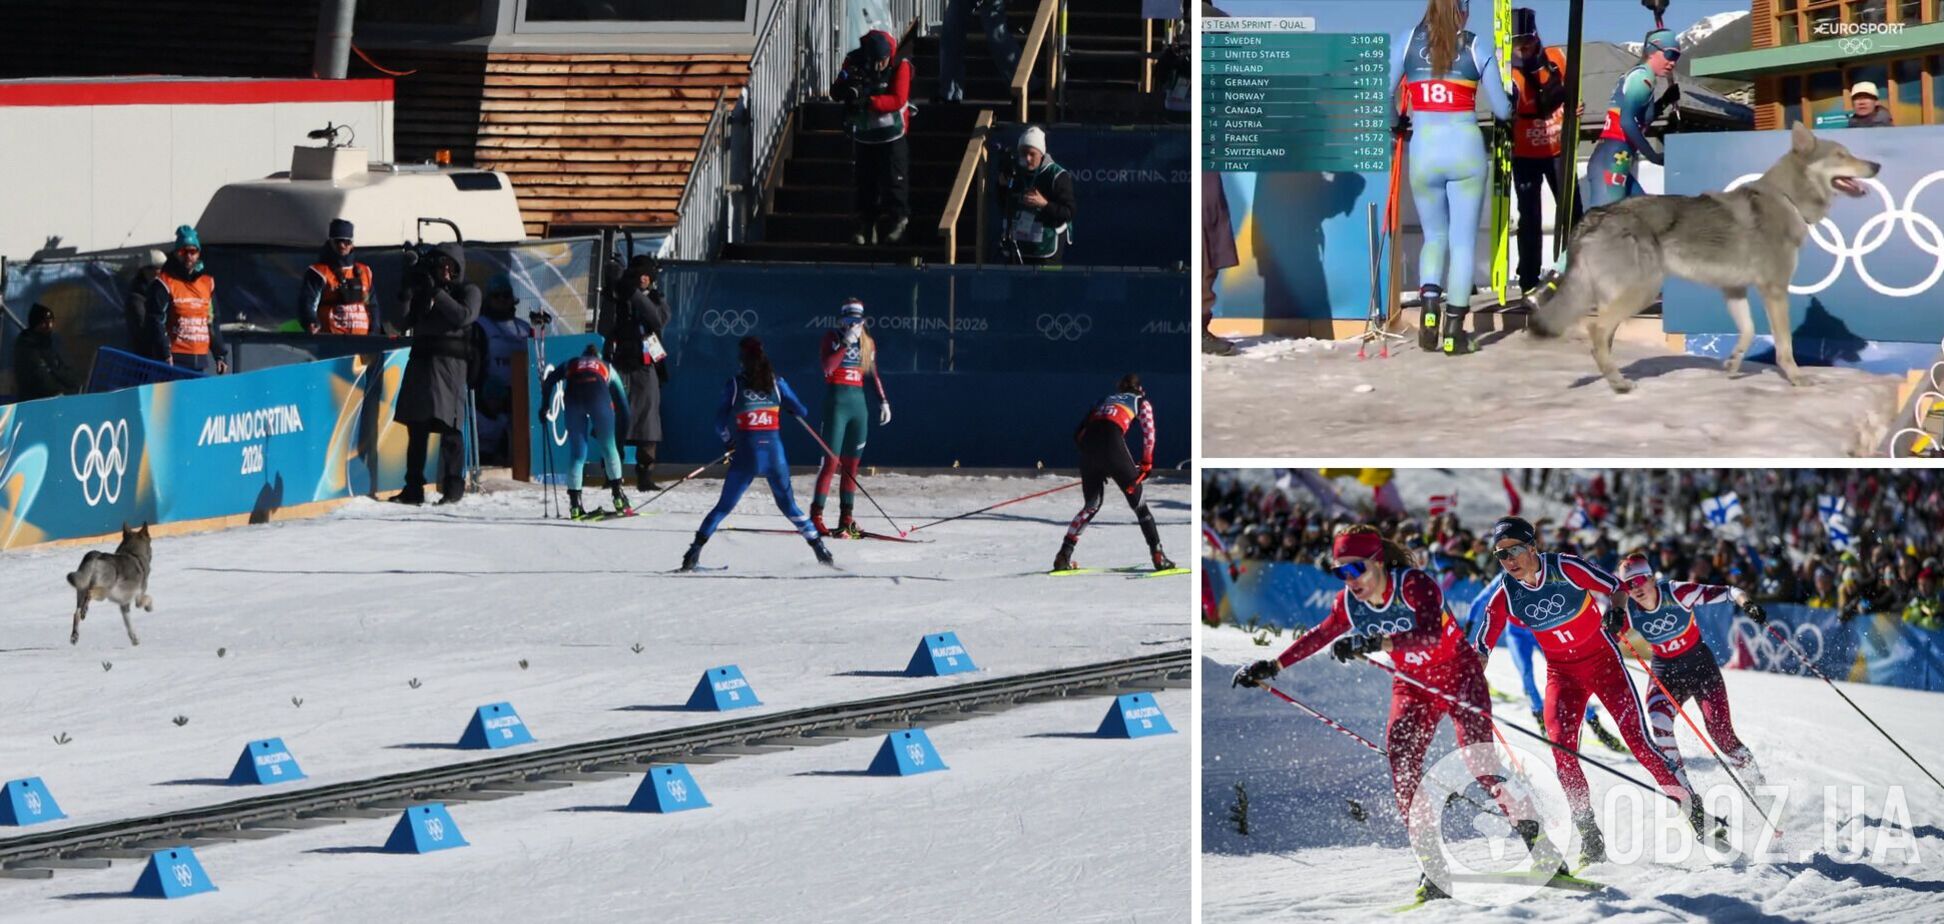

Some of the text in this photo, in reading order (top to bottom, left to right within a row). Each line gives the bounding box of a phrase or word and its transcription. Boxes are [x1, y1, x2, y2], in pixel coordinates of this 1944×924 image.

[1095, 168, 1168, 183] CORTINA
[878, 316, 950, 331] CORTINA
[953, 318, 989, 331] 2026
[197, 403, 304, 446] MILANO CORTINA
[241, 444, 264, 475] 2026
